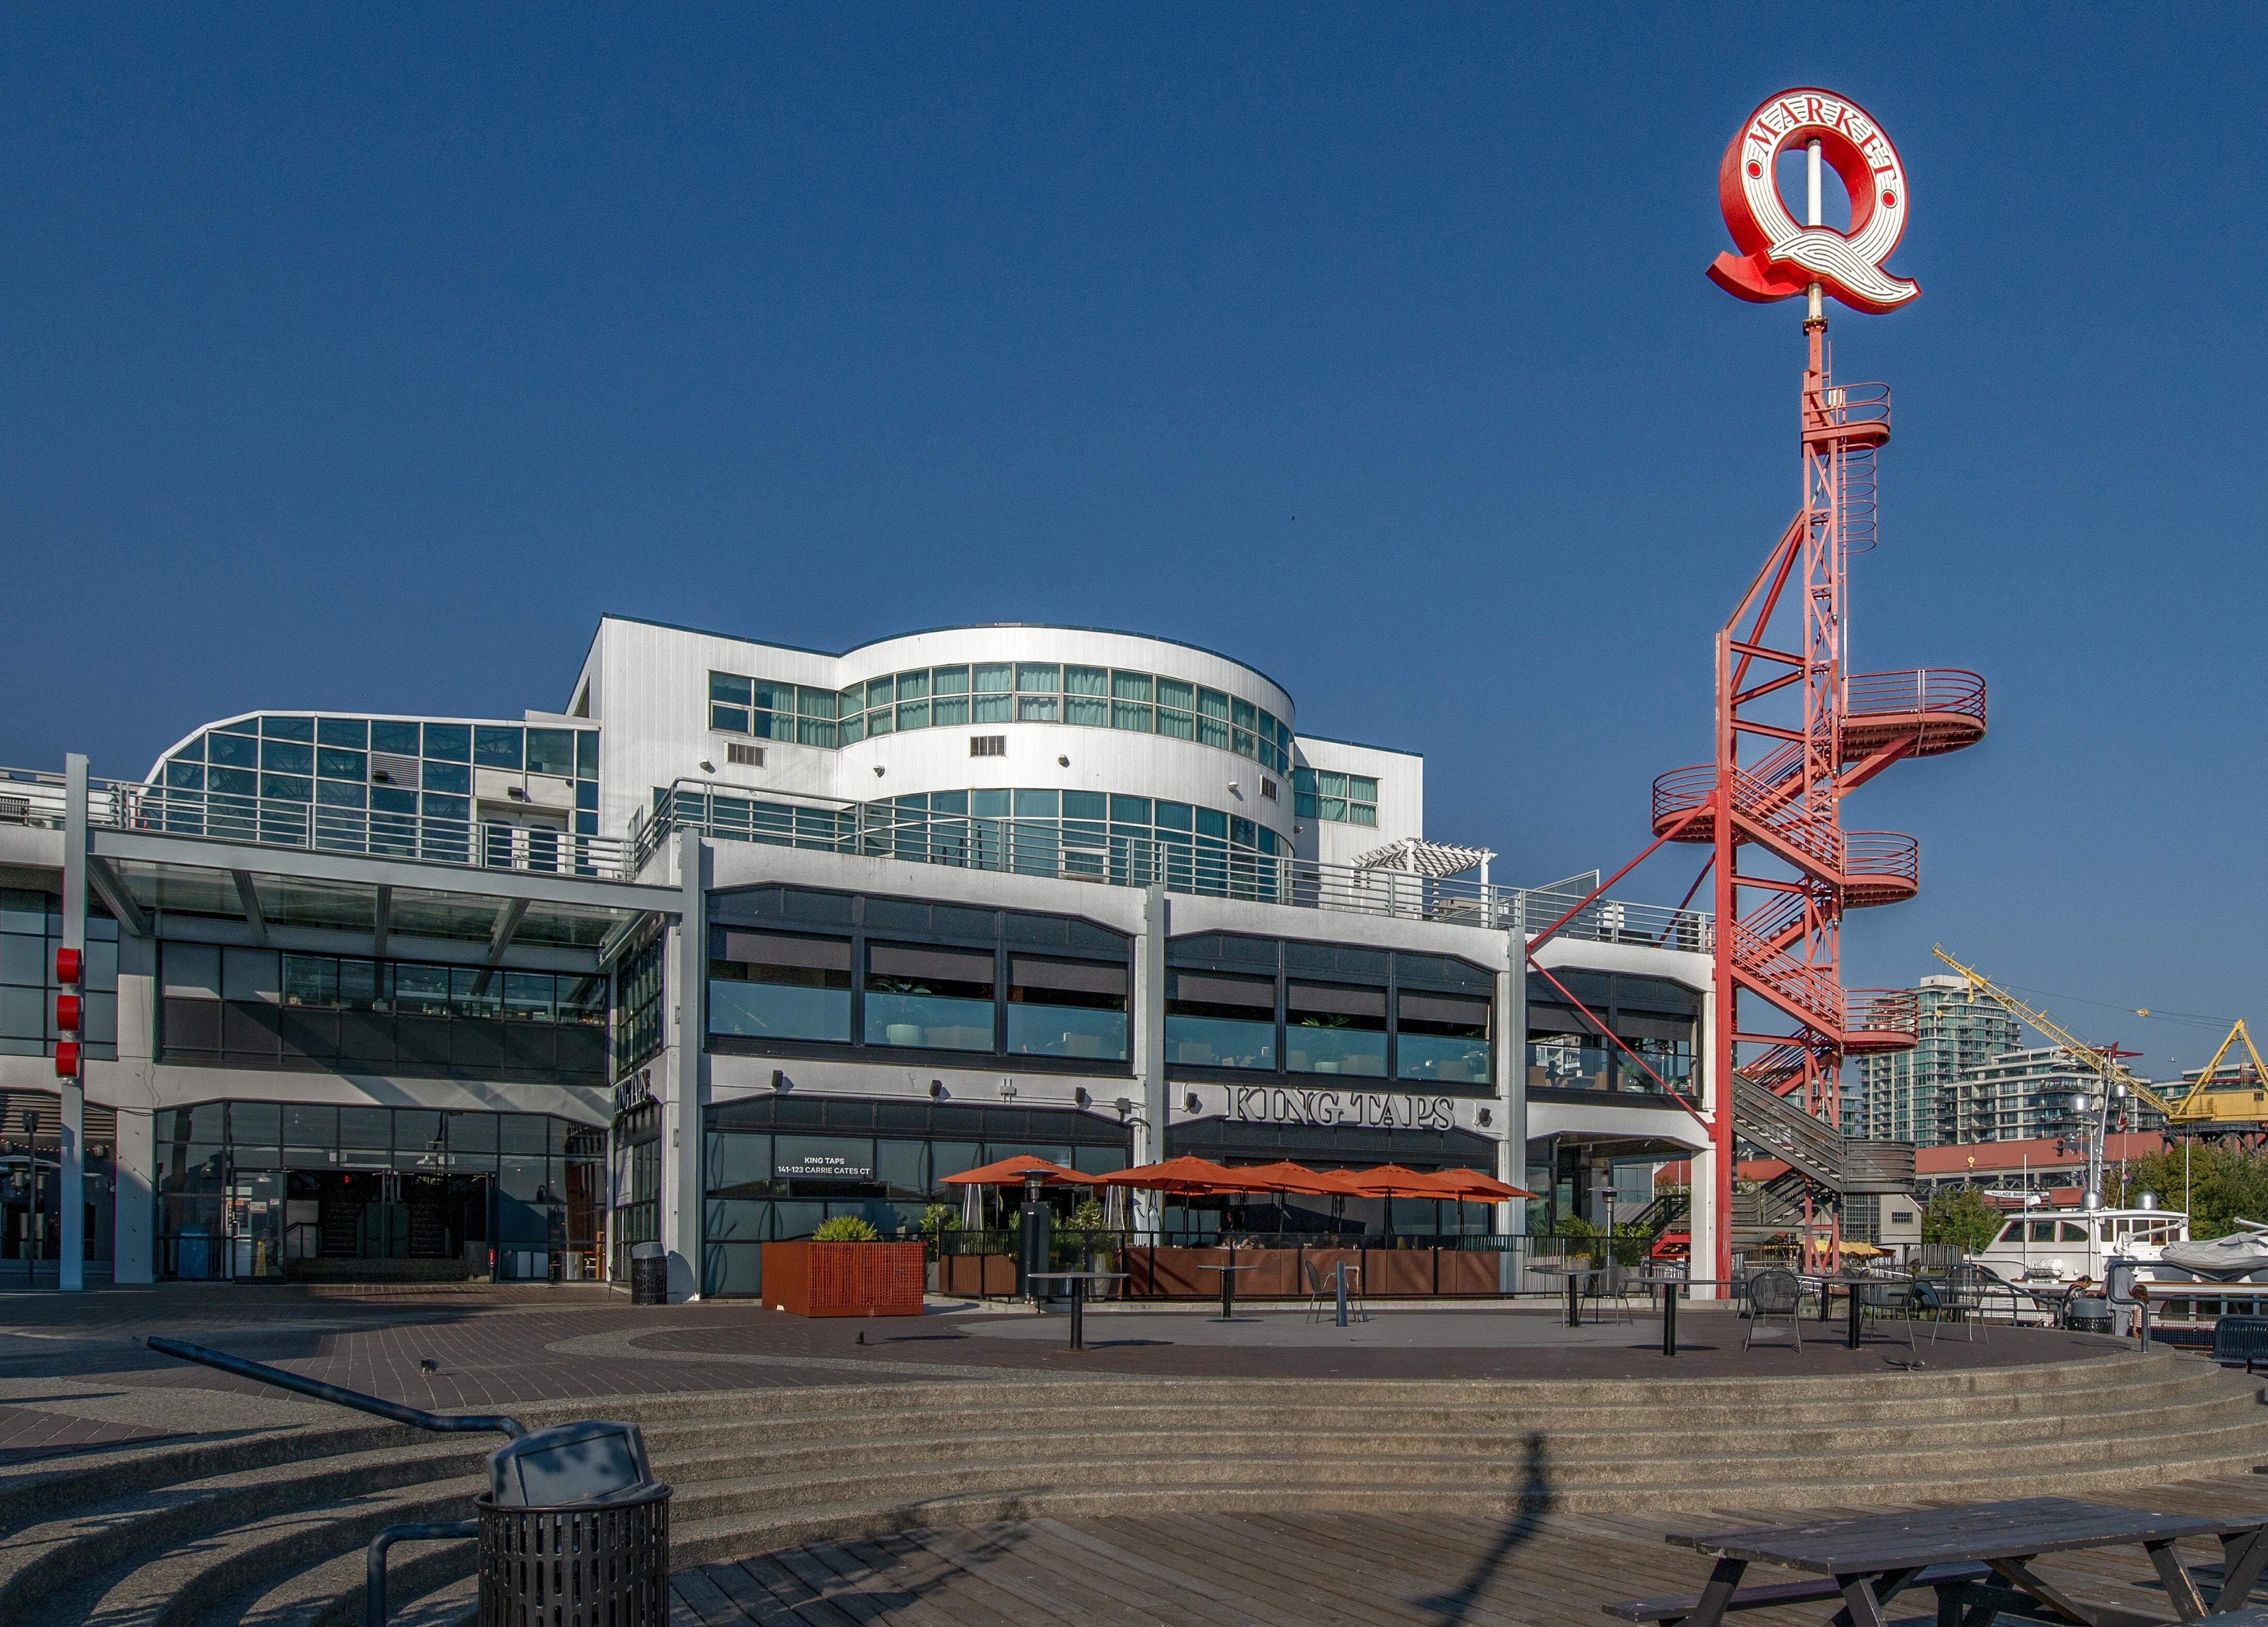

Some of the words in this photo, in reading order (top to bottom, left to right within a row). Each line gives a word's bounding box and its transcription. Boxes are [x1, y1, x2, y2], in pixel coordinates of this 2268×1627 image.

[1748, 96, 1898, 181] MARKET
[1225, 1085, 1344, 1126] KING
[1350, 1091, 1456, 1131] TAPS
